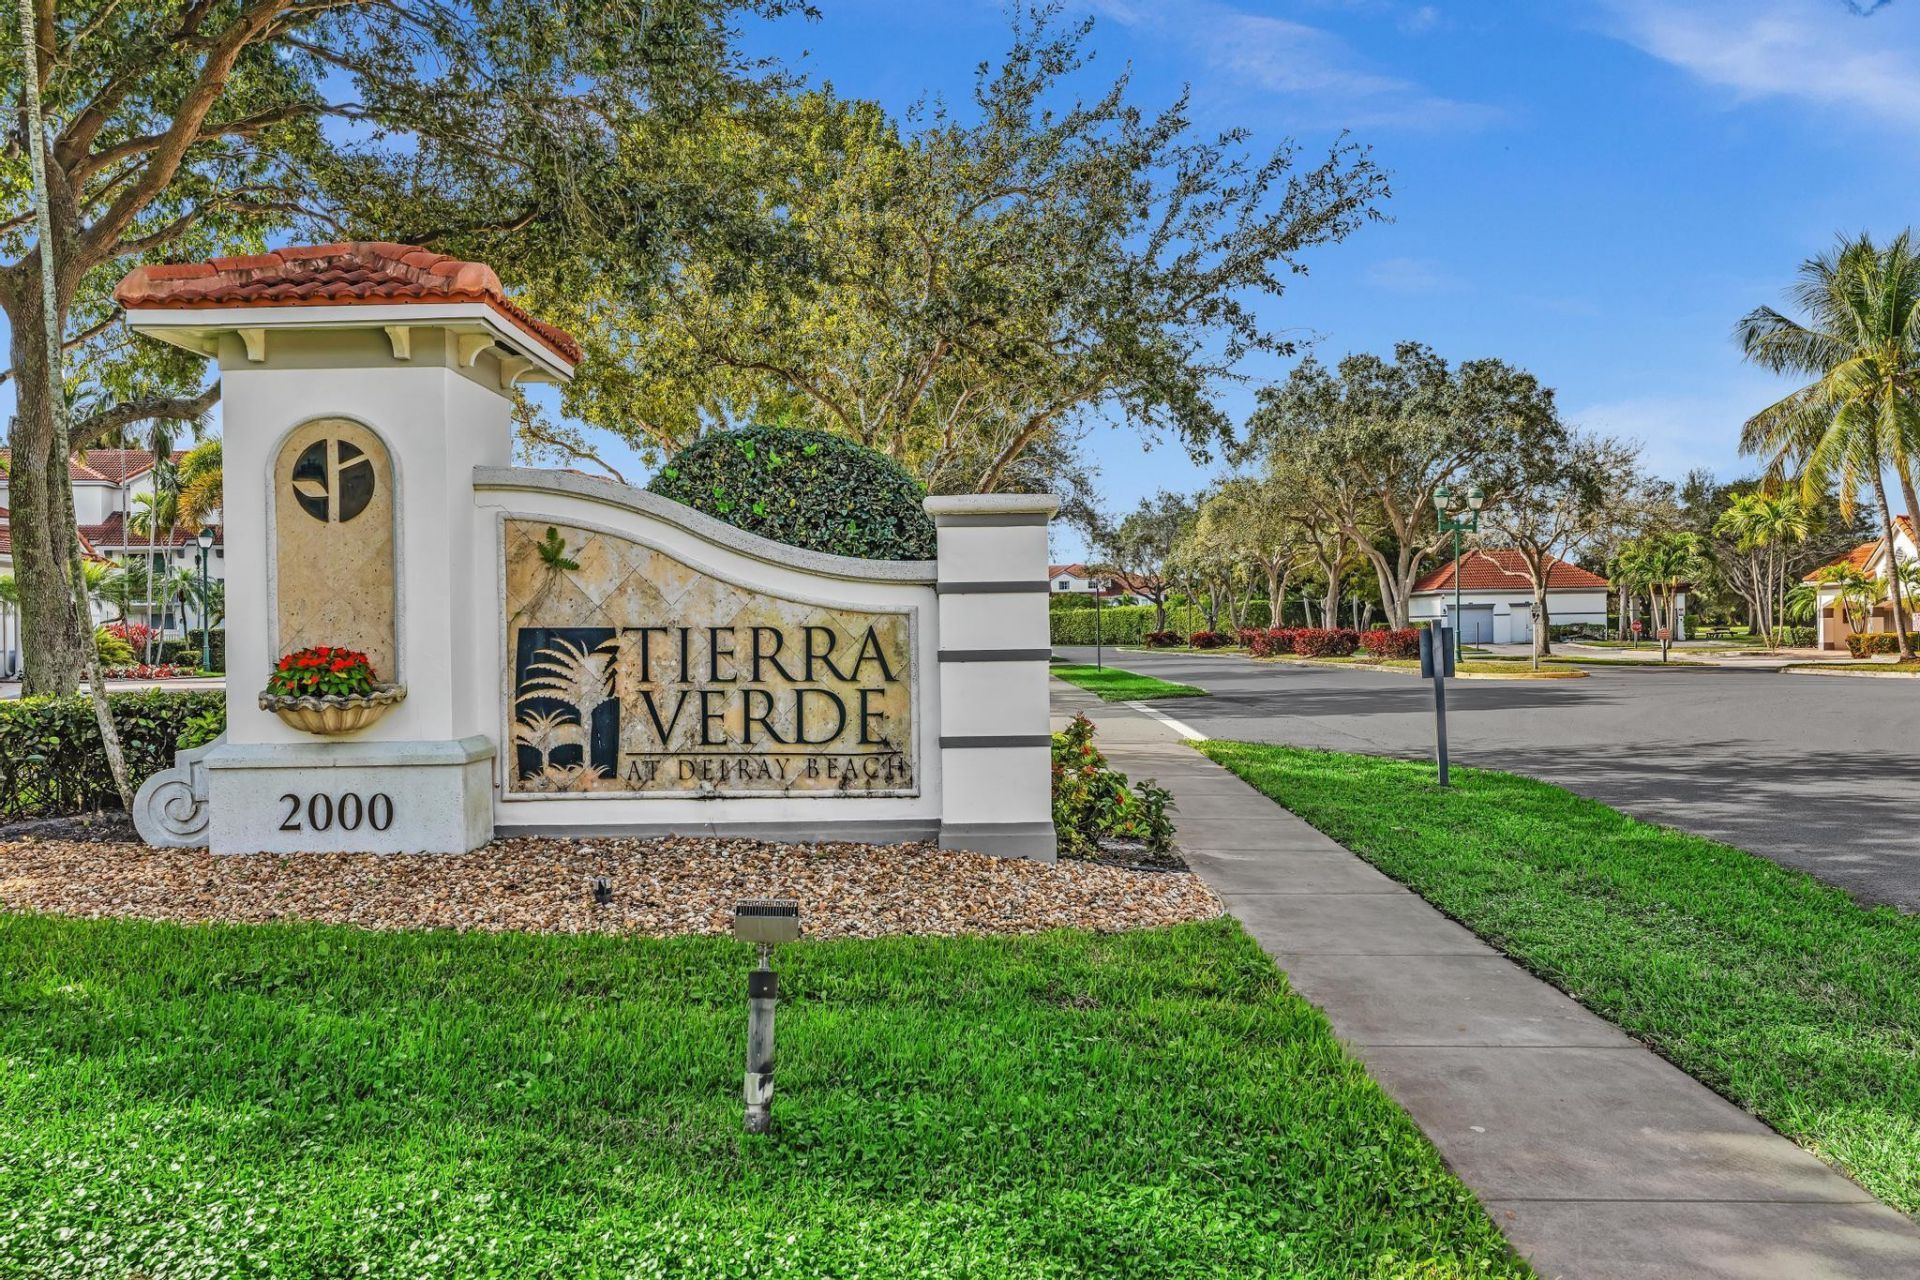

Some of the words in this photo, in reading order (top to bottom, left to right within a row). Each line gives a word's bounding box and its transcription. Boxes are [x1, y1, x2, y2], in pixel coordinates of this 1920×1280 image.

[621, 625, 900, 683] TIERRA
[636, 688, 889, 746] VERDE
[628, 760, 663, 781] AT
[677, 758, 790, 781] DELRAY
[807, 756, 905, 780] BEACH
[279, 792, 393, 831] 2000
